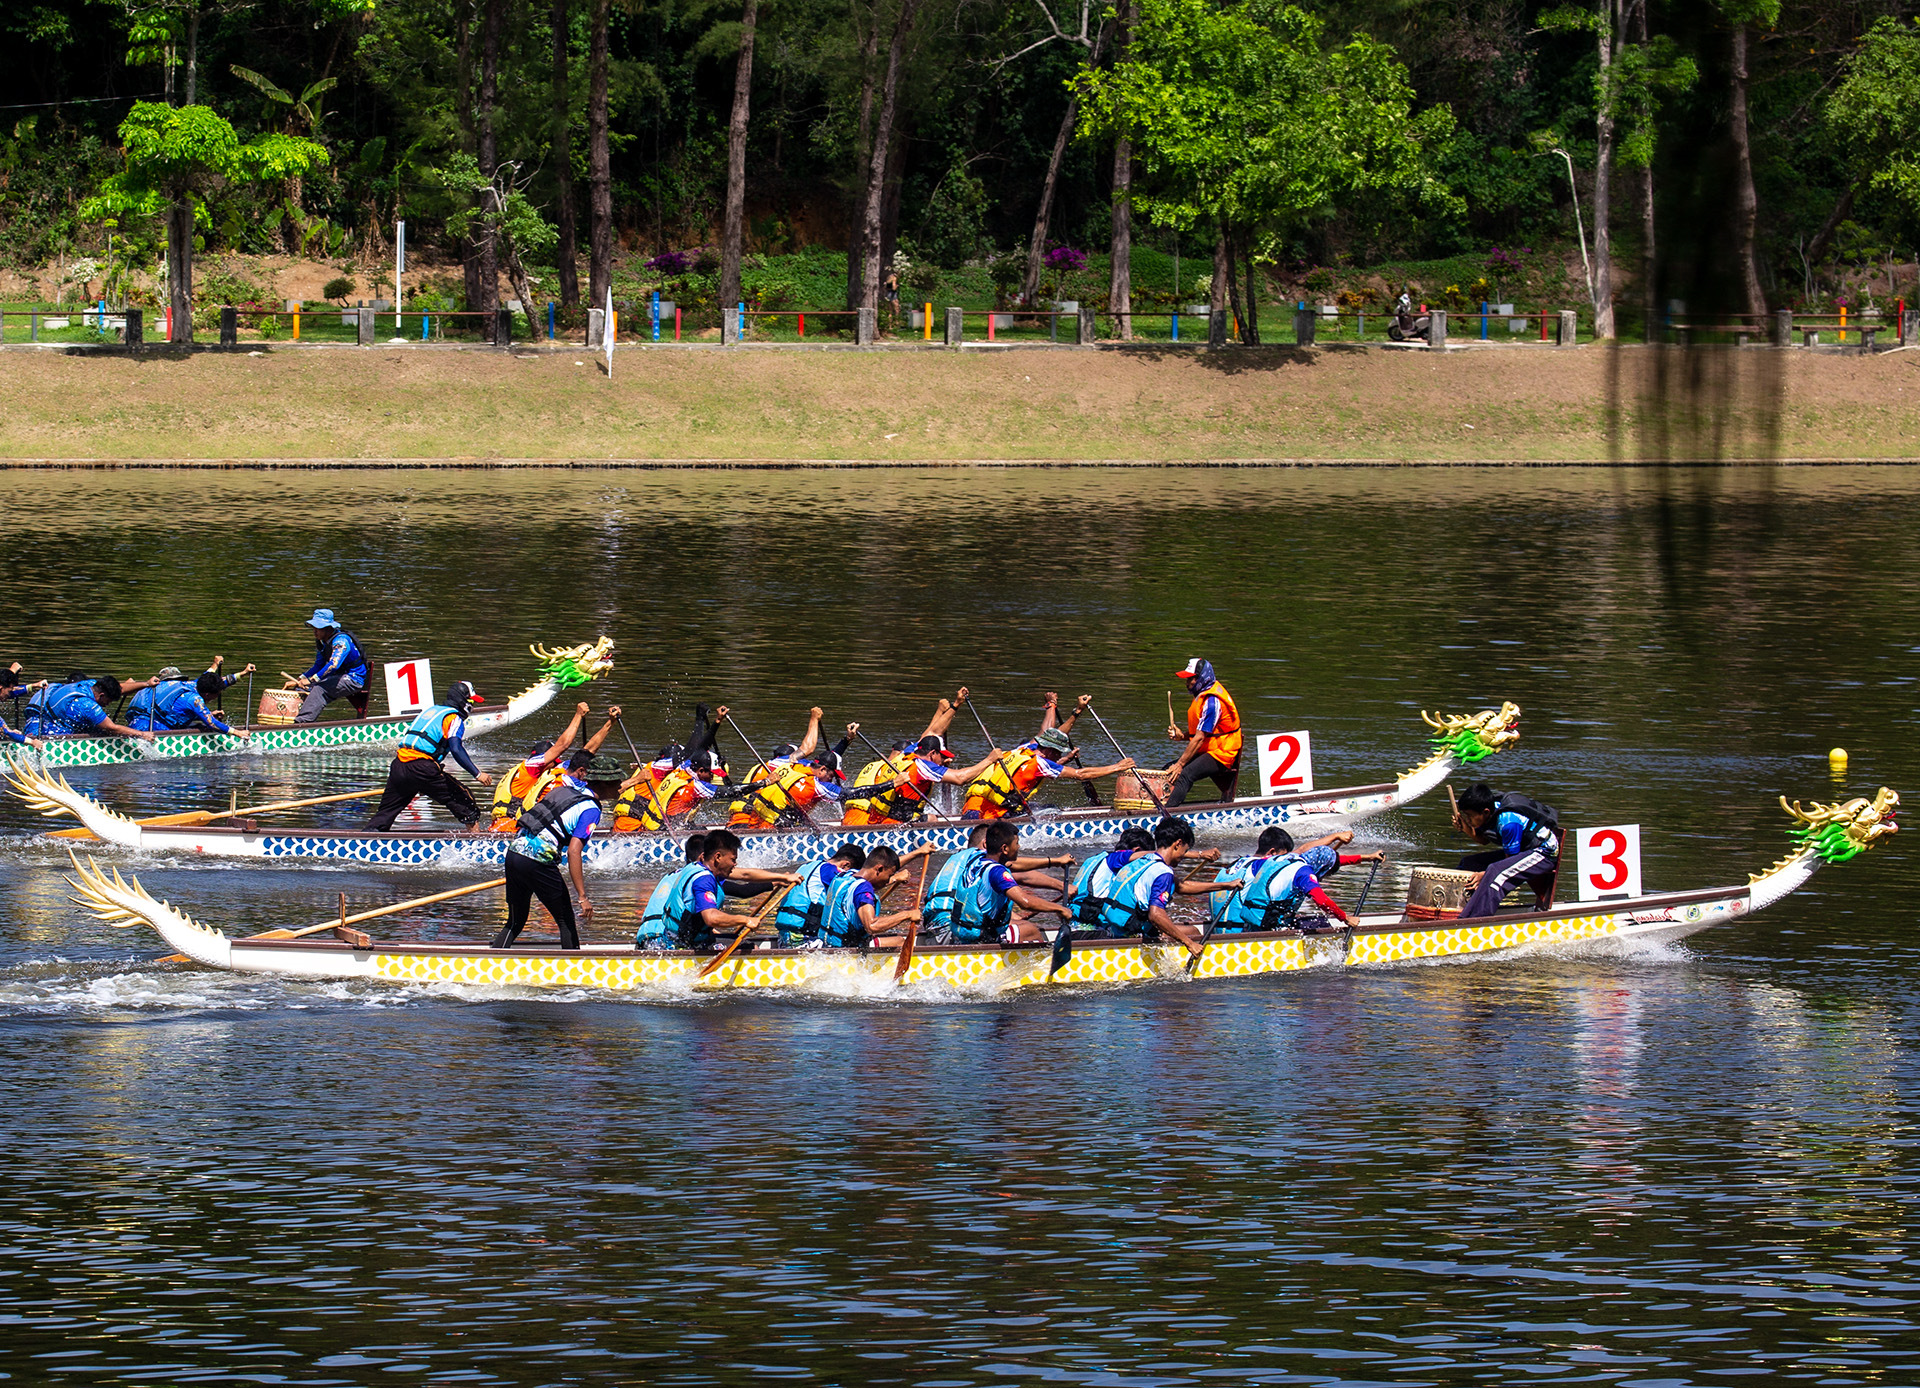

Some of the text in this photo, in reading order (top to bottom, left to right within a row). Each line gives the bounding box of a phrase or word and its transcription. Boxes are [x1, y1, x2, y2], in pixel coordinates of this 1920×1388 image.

[397, 662, 419, 705] 1
[1268, 735, 1304, 787] 2
[1589, 829, 1629, 890] 3
